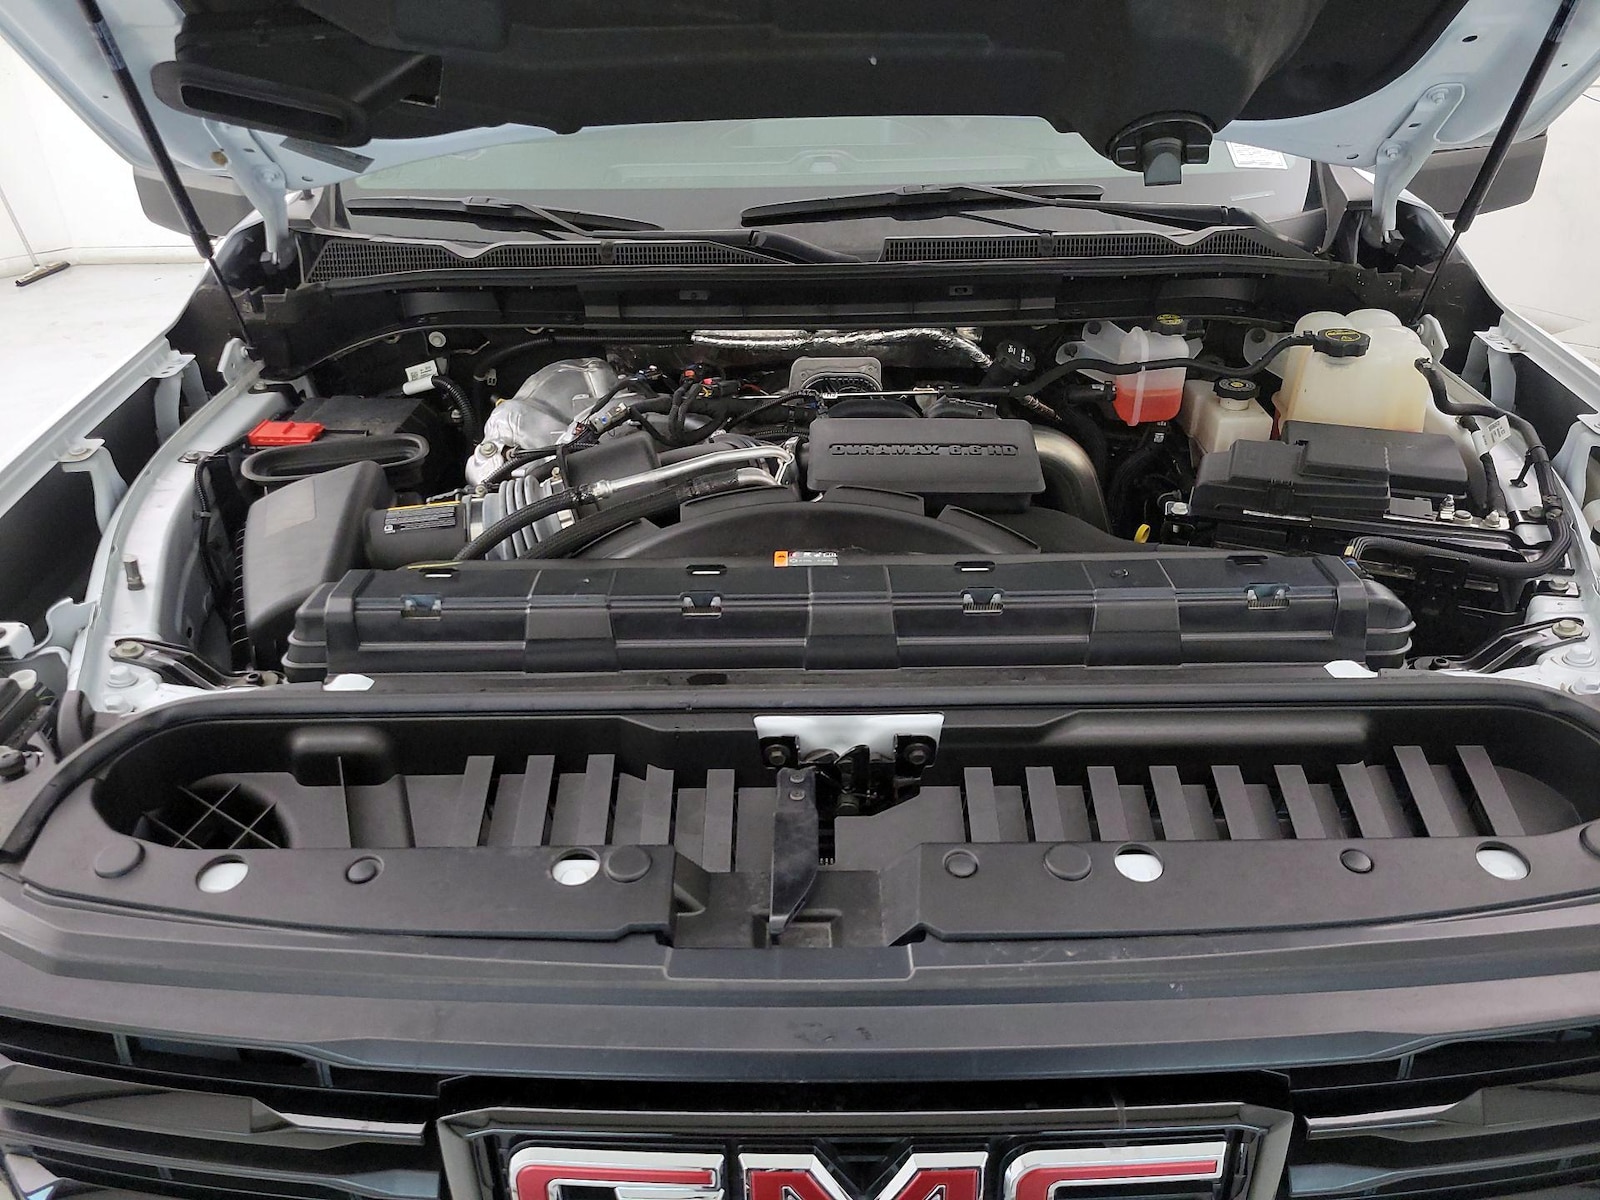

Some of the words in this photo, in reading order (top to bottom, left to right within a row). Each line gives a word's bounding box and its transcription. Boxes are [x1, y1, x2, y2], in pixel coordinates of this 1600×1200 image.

[829, 443, 939, 456] DURAMAX
[948, 444, 982, 456] 6.6
[986, 444, 1017, 457] HD
